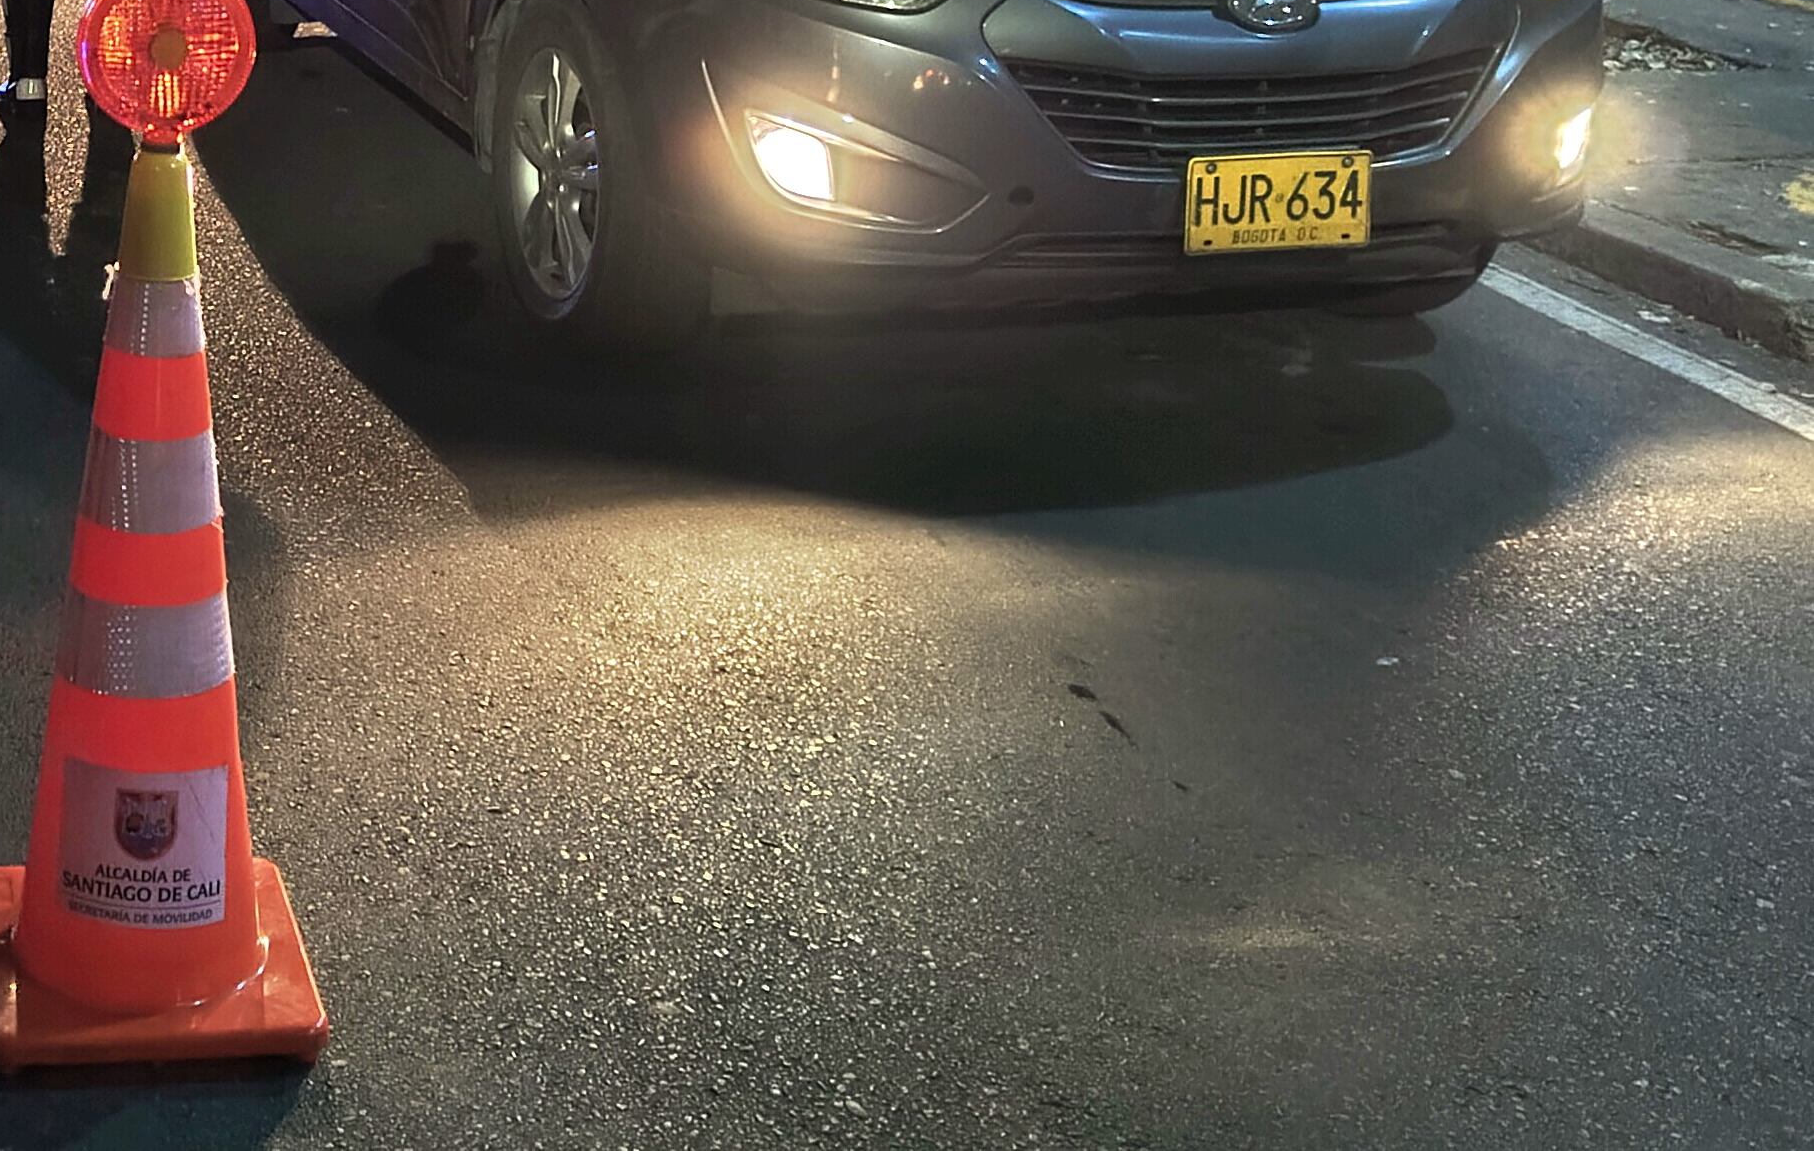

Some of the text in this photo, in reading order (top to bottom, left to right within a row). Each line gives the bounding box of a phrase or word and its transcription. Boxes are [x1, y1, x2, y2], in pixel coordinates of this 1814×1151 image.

[1194, 170, 1363, 227] HJR 634
[1232, 228, 1286, 244] BOGOTA
[96, 864, 191, 883] ALCALDÍA DE
[62, 871, 220, 902] SANTIAGO DE CALI
[134, 911, 149, 923] DE
[152, 909, 213, 924] MOVILIDAD
